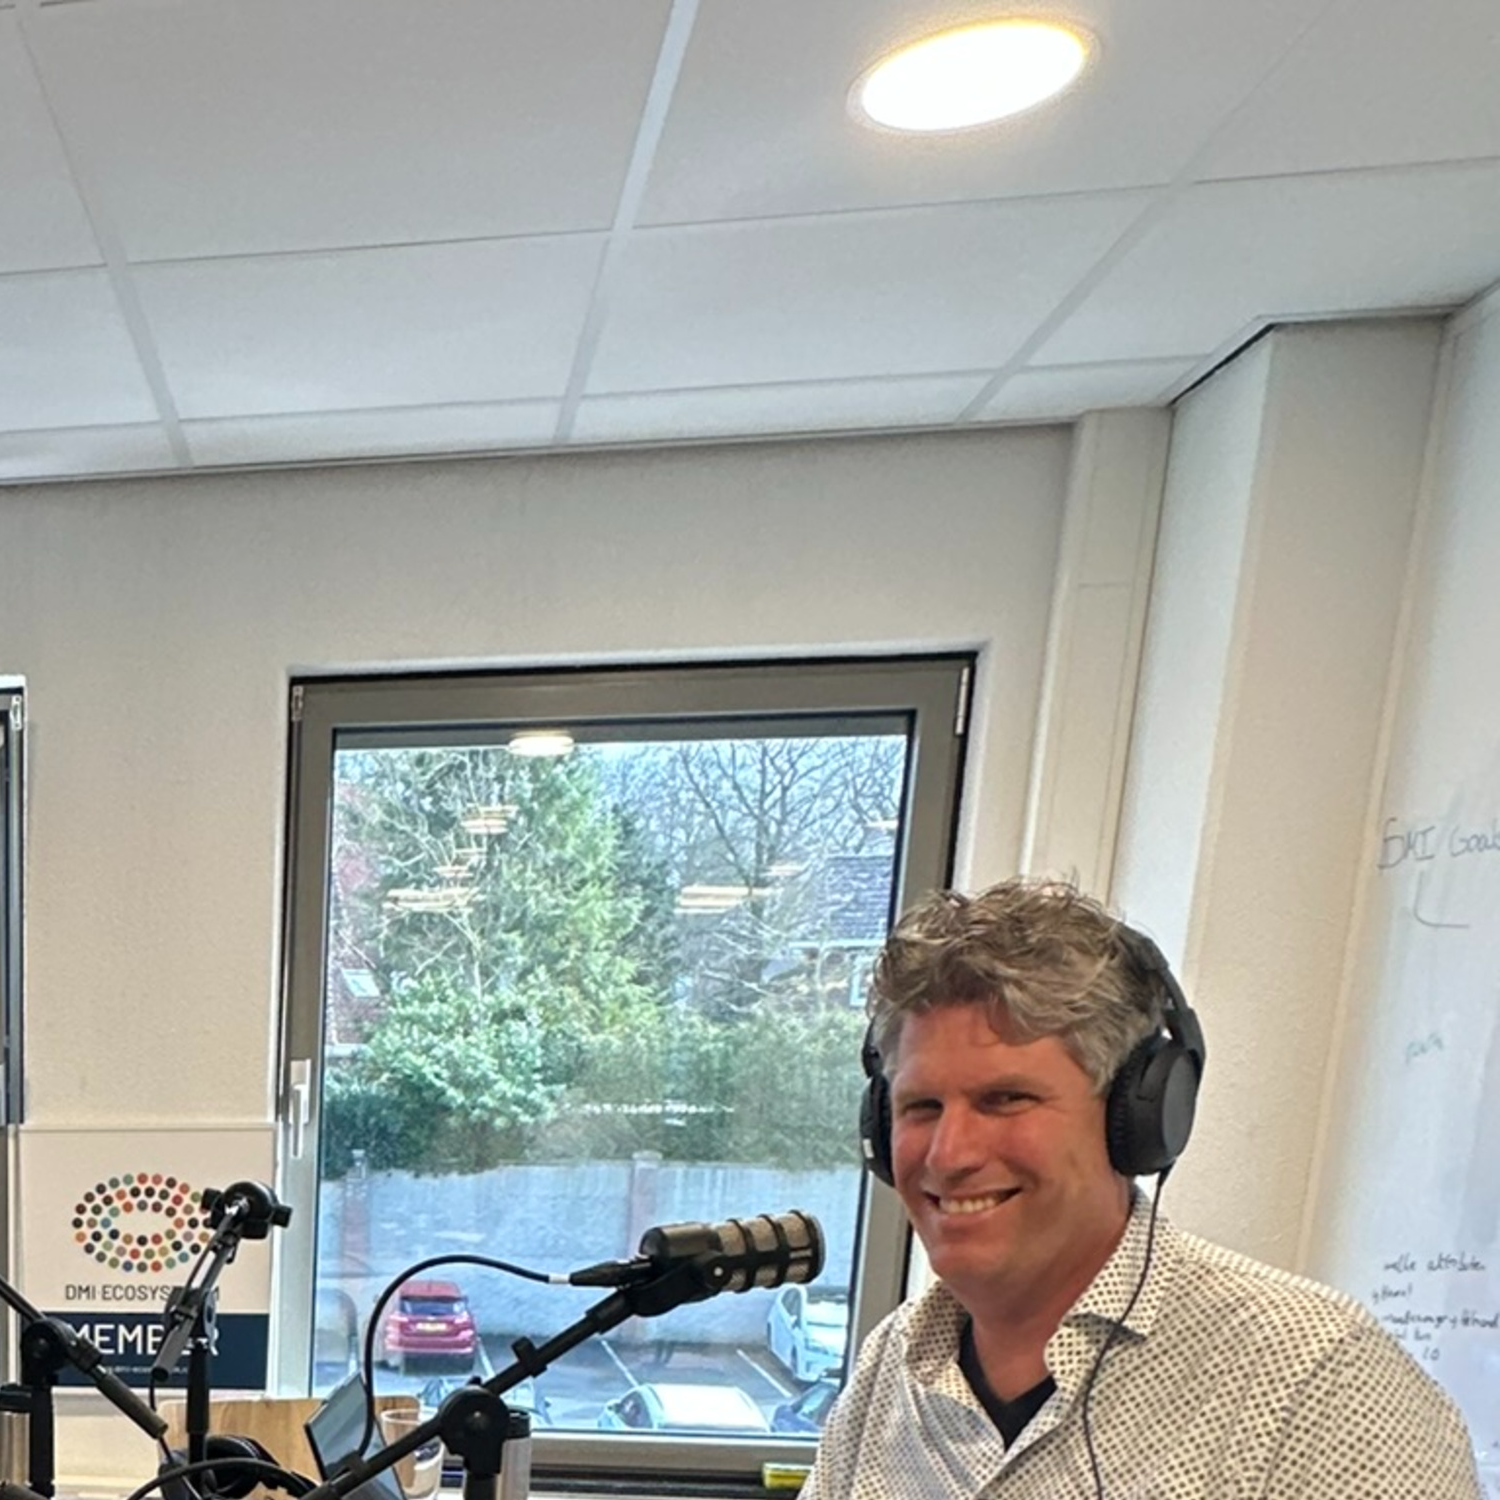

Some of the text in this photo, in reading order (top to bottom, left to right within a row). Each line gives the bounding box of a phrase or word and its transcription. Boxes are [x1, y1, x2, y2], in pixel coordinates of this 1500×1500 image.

[65, 1284, 220, 1302] DMI ECOSYS
[66, 1323, 219, 1357] MEMB
